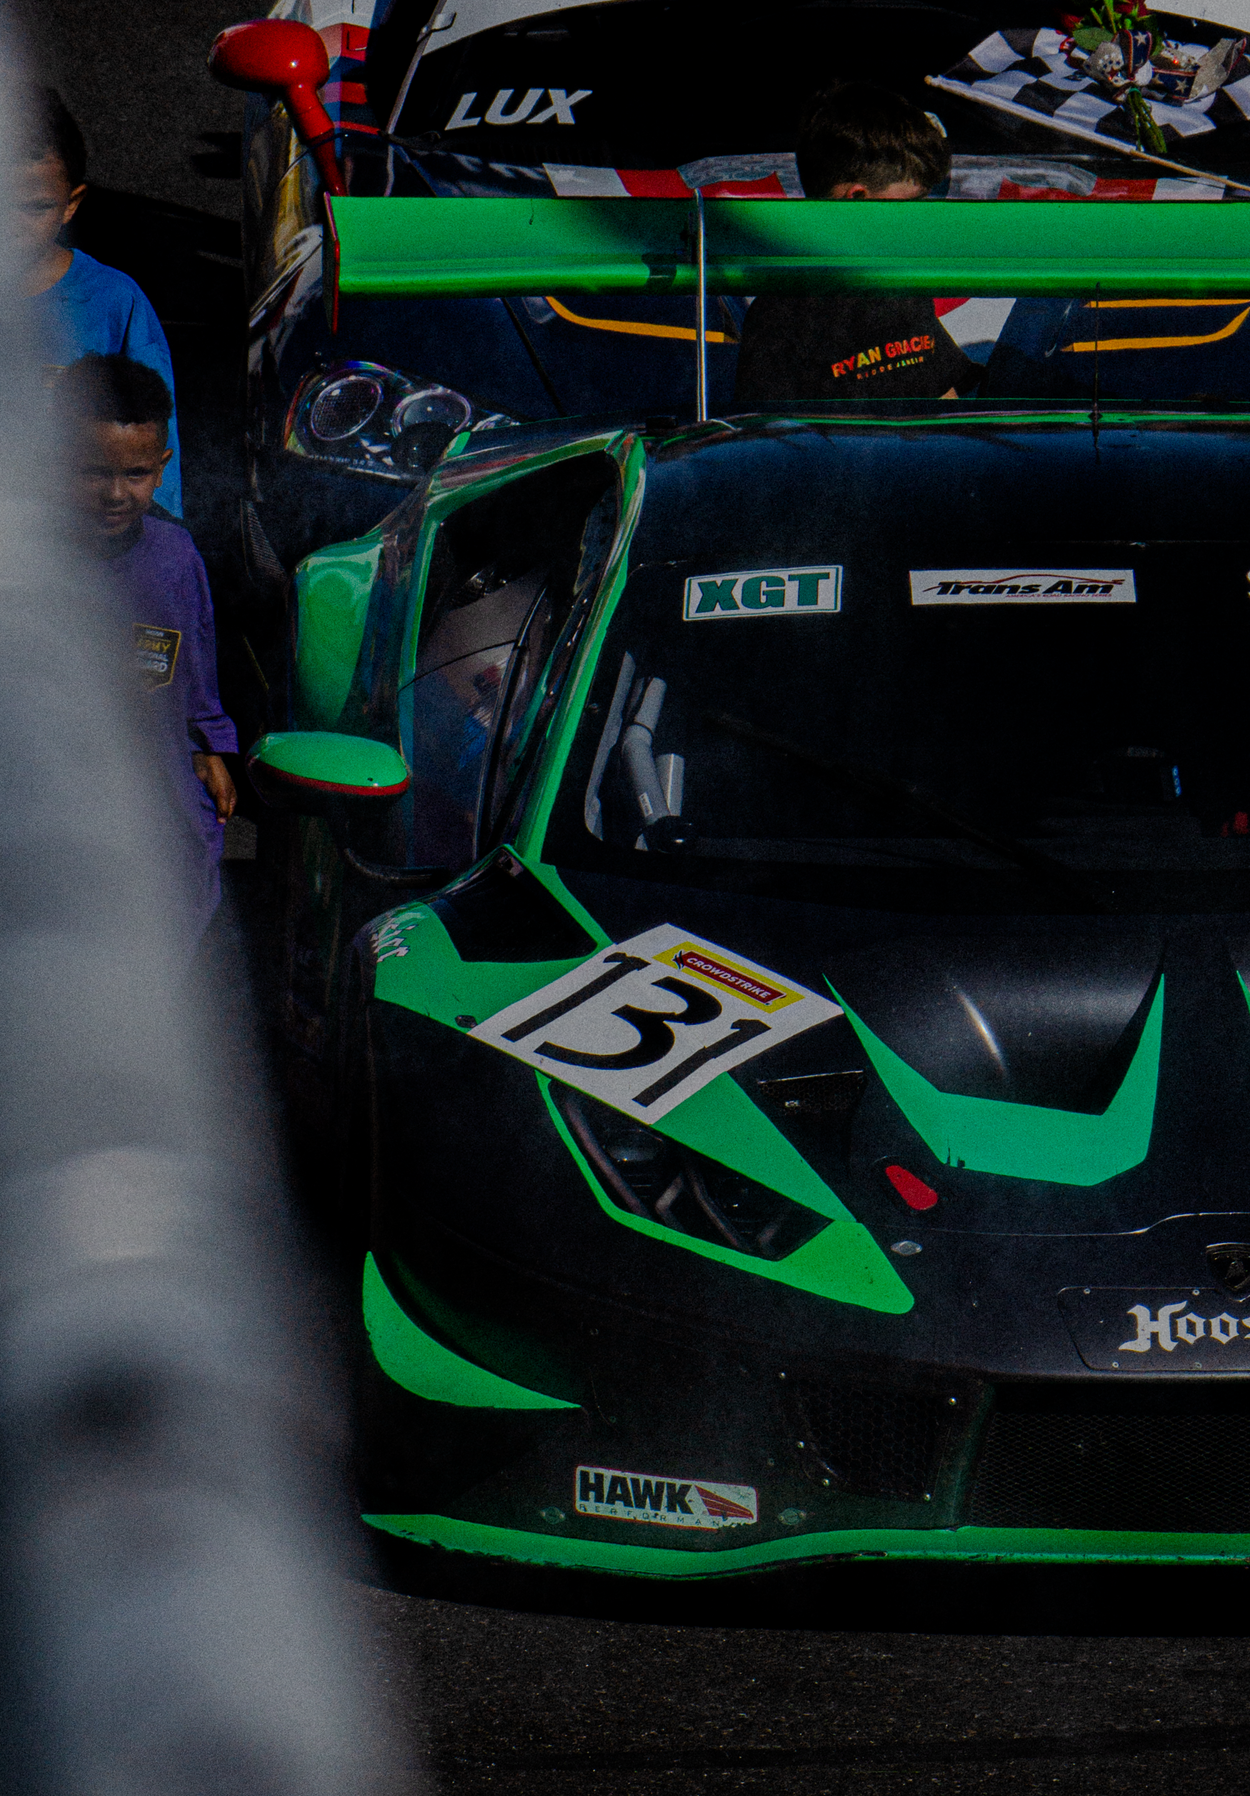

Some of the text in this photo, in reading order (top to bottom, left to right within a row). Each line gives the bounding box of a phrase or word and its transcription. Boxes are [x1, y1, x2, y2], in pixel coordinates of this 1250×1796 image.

[444, 88, 593, 131] LUX
[831, 346, 882, 378] RYAN
[695, 572, 830, 613] XGT
[937, 580, 1114, 595] Trans Am
[686, 956, 772, 998] CROWDSTRIKE
[501, 952, 771, 1108] 131
[579, 1470, 695, 1515] HAWK
